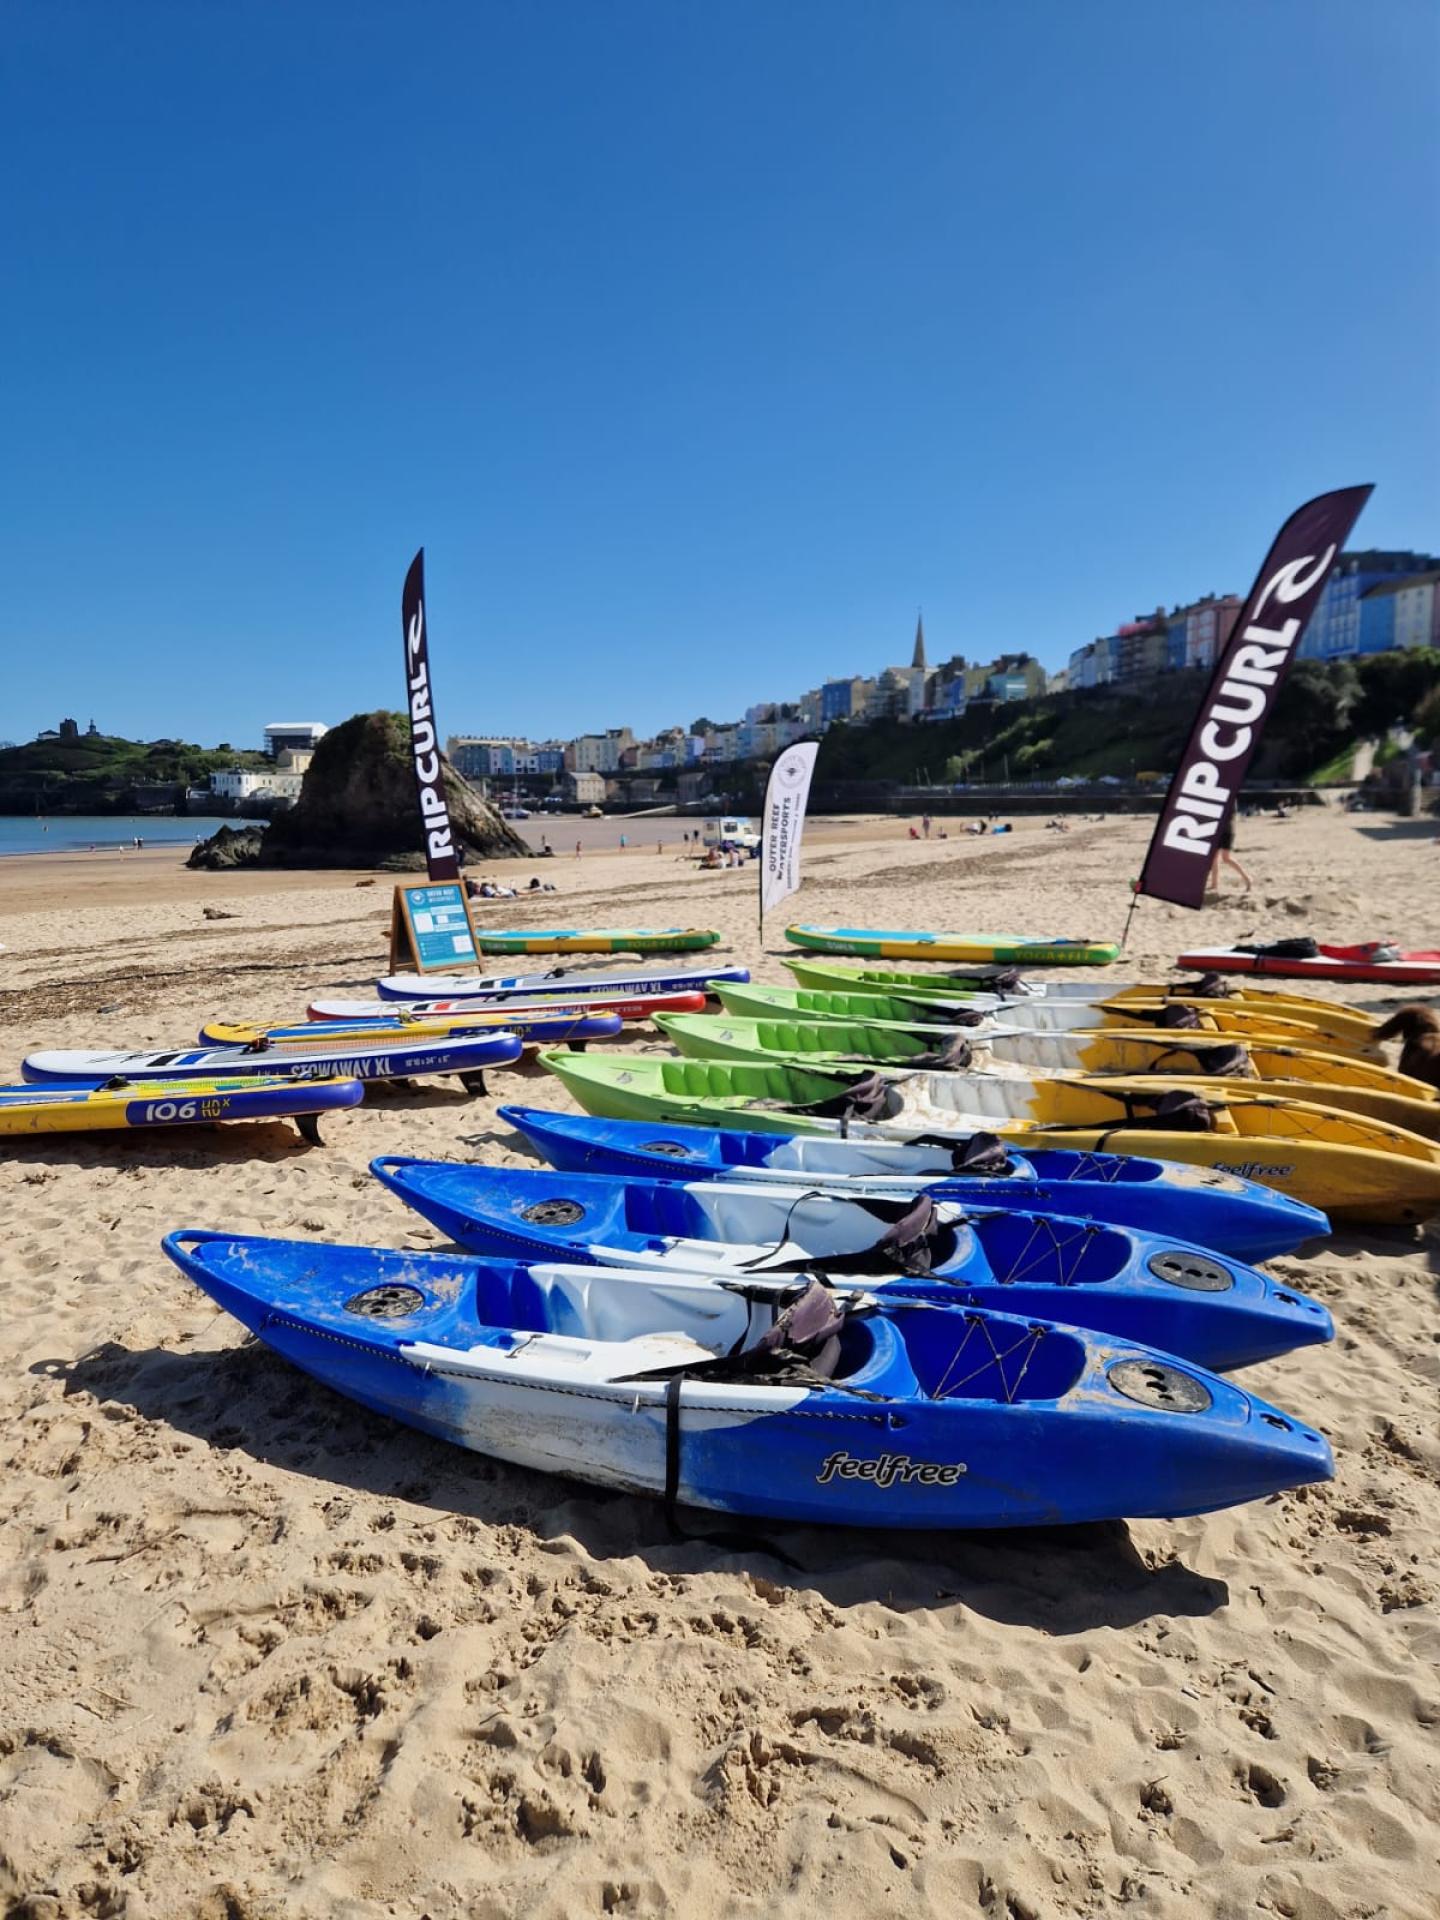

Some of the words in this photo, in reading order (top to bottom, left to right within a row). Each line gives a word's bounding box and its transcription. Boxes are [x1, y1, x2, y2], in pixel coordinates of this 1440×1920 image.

[410, 662, 439, 783] CURL
[1162, 761, 1231, 857] RIP
[1200, 617, 1302, 762] CURL
[421, 787, 454, 858] RIP
[770, 803, 781, 831] REEF
[768, 835, 778, 873] OUTER
[777, 797, 791, 880] WATERSPORTS
[290, 1058, 371, 1078] STOWAWAY
[375, 1056, 394, 1076] XL
[146, 1101, 197, 1121] 106
[1212, 1161, 1296, 1179] feelfree
